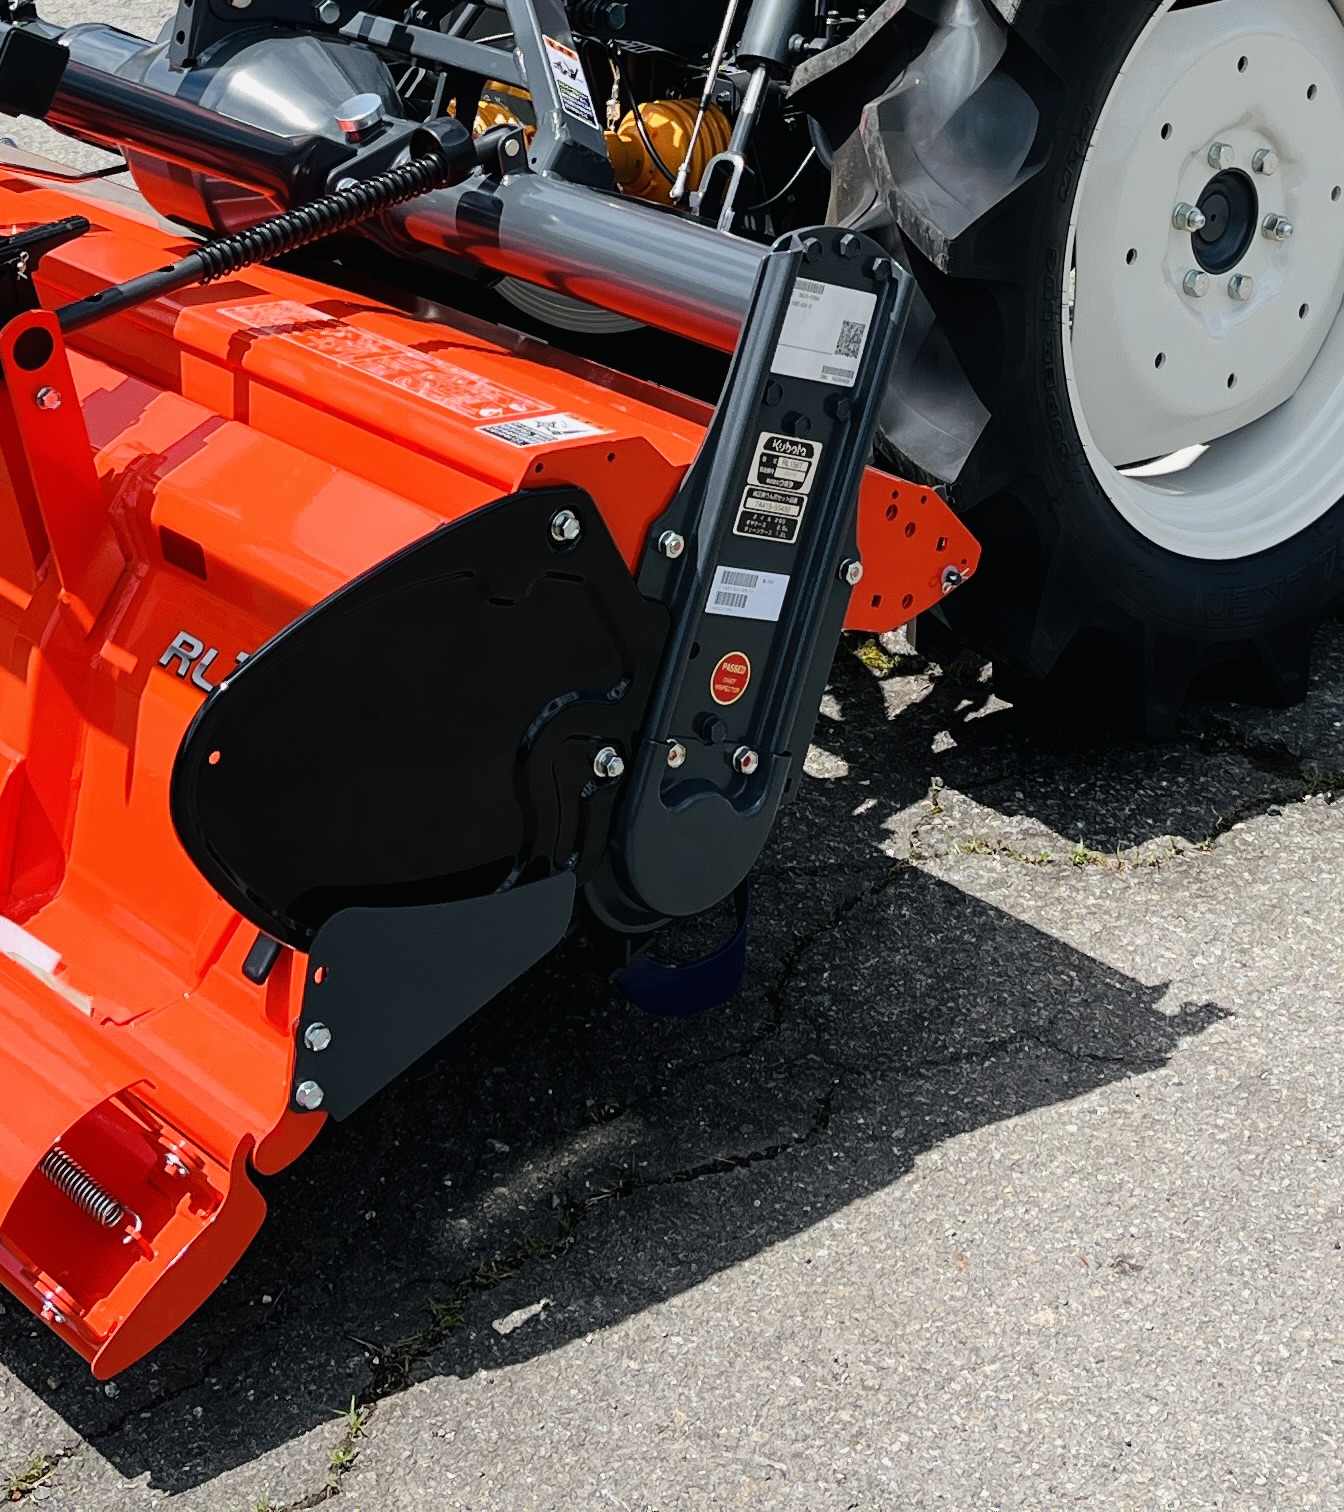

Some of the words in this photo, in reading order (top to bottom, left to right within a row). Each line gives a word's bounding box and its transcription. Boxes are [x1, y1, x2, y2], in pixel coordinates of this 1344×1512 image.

[772, 438, 807, 456] Kubota
[159, 631, 249, 692] RL
[722, 662, 747, 675] PASSED
